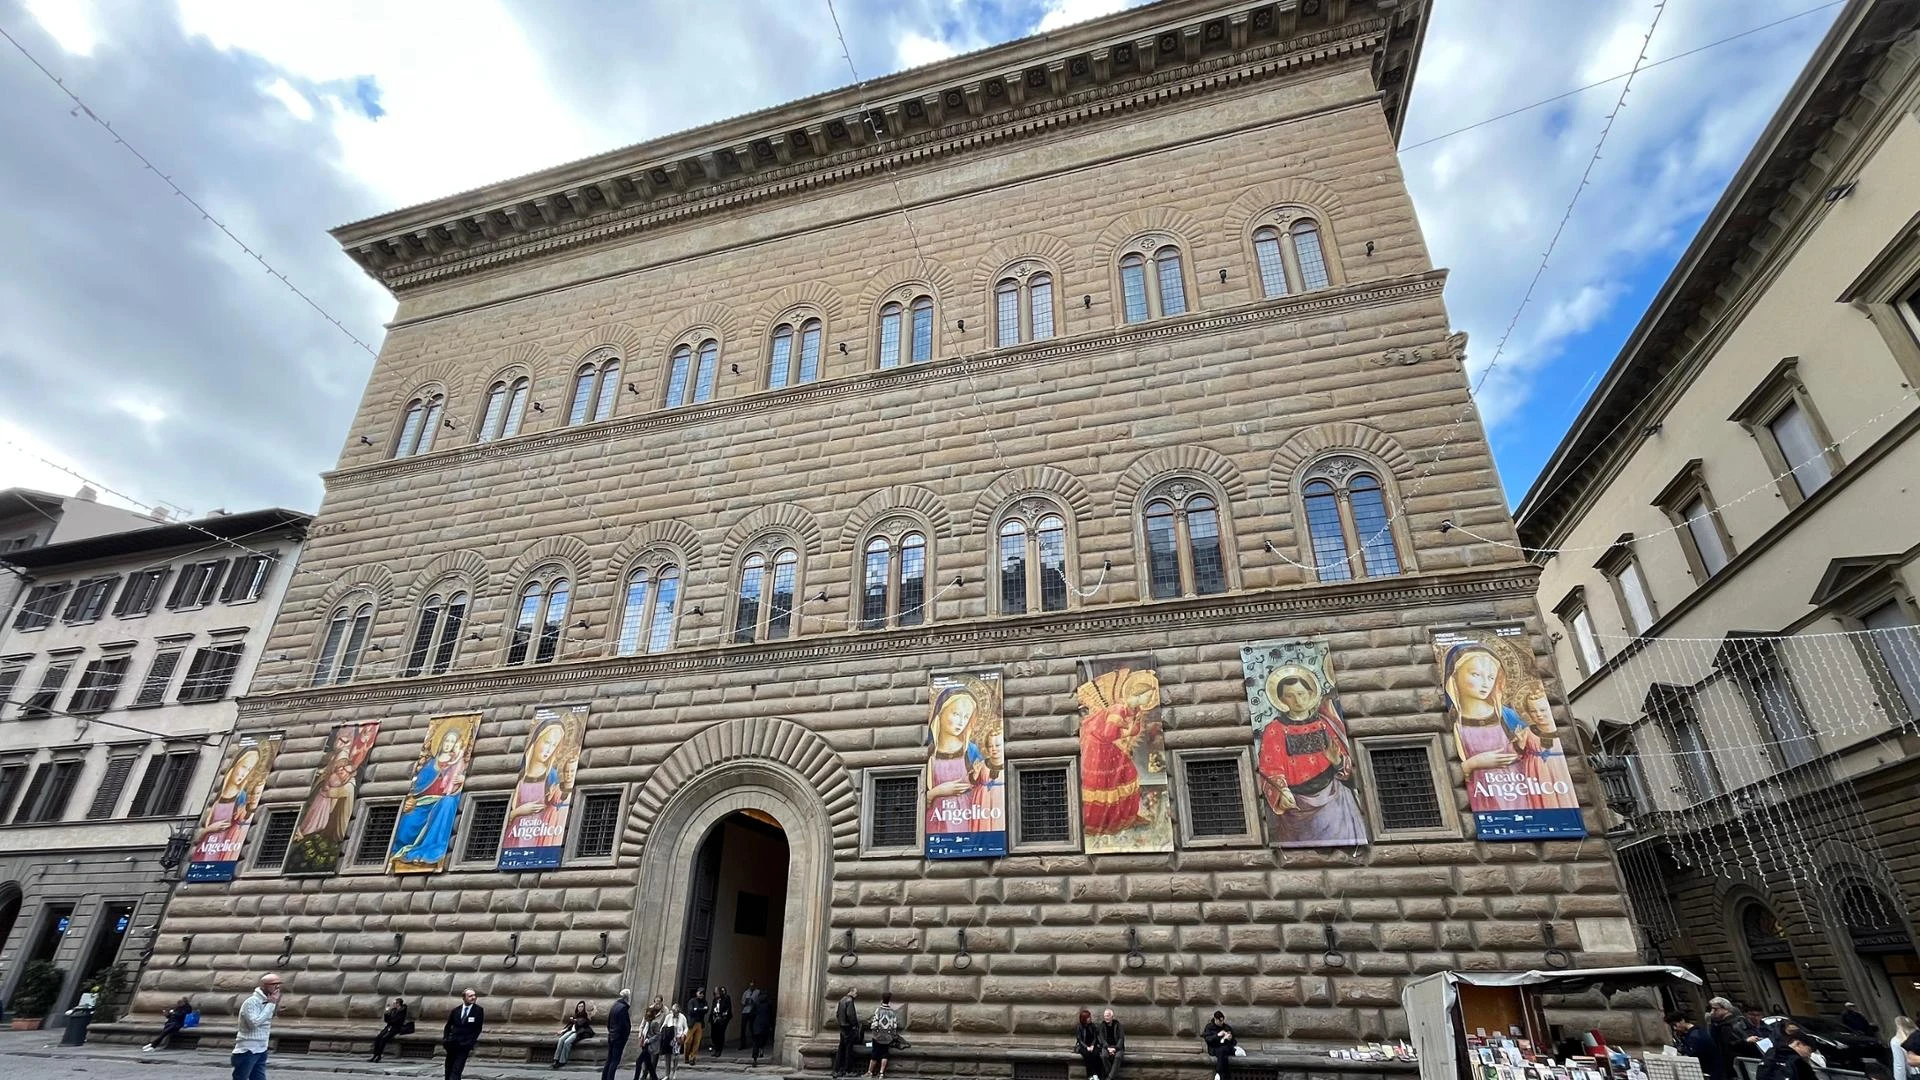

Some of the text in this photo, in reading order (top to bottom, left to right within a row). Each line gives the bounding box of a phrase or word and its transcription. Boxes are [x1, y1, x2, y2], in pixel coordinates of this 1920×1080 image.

[1485, 772, 1526, 783] Beato
[1474, 777, 1568, 801] Angelico
[942, 799, 957, 809] Fra
[930, 803, 1002, 825] Angelico
[508, 823, 562, 840] Angelico
[197, 839, 240, 855] Angelico
